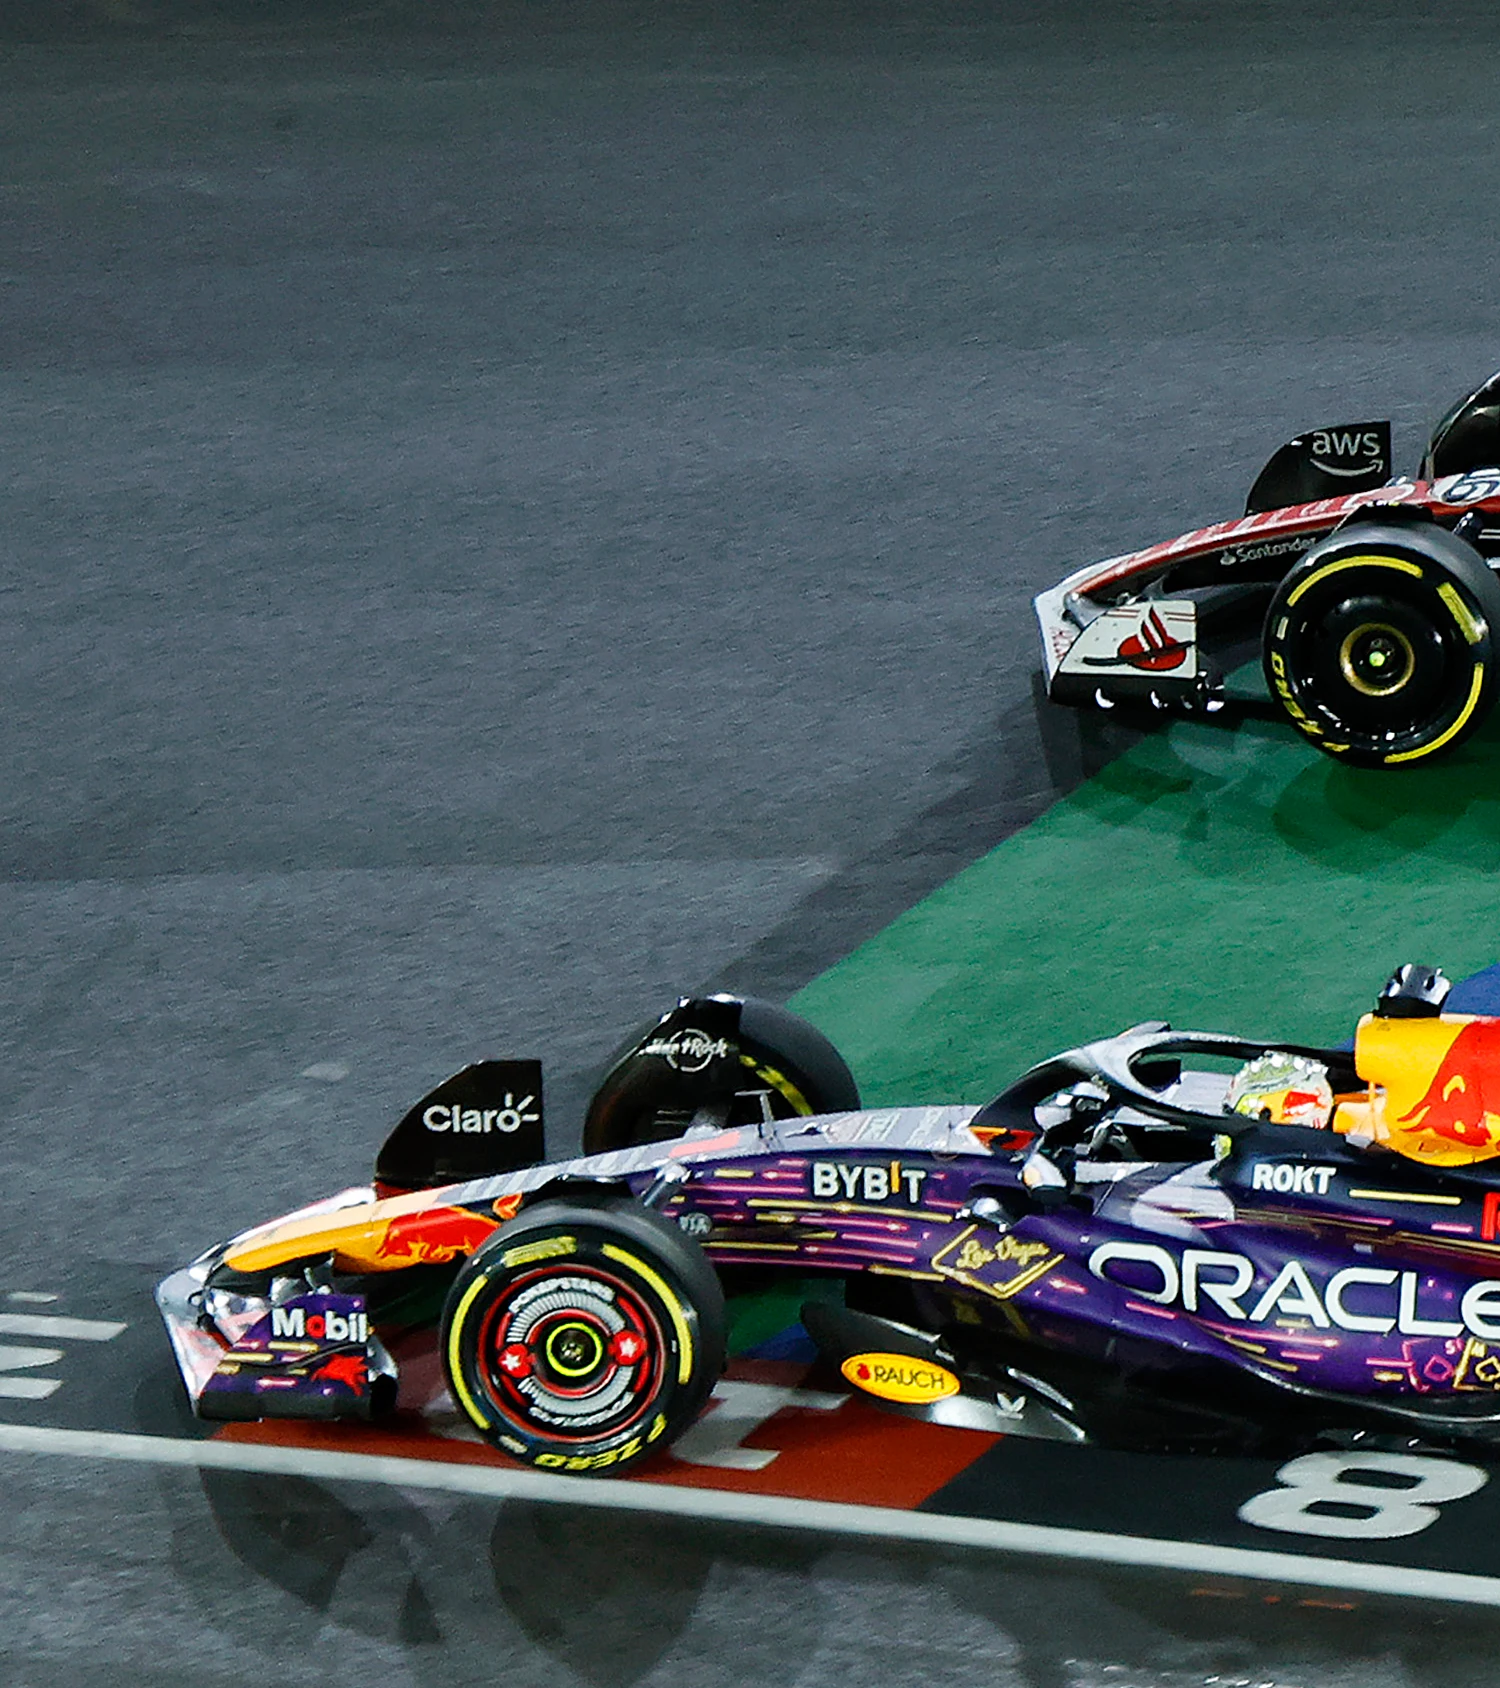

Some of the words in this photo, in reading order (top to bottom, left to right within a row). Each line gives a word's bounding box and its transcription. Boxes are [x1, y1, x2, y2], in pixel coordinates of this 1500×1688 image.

[1312, 430, 1381, 457] aws
[1236, 537, 1316, 563] Santander
[423, 1104, 521, 1133] Claro
[813, 1160, 926, 1203] BYBIT
[1252, 1163, 1336, 1195] ROKT
[956, 1240, 996, 1269] Las
[995, 1235, 1050, 1266] Vegas
[271, 1308, 368, 1343] Mobil
[873, 1365, 944, 1390] RAUCH
[533, 1436, 643, 1470] ZERO
[1238, 1449, 1490, 1539] 8
